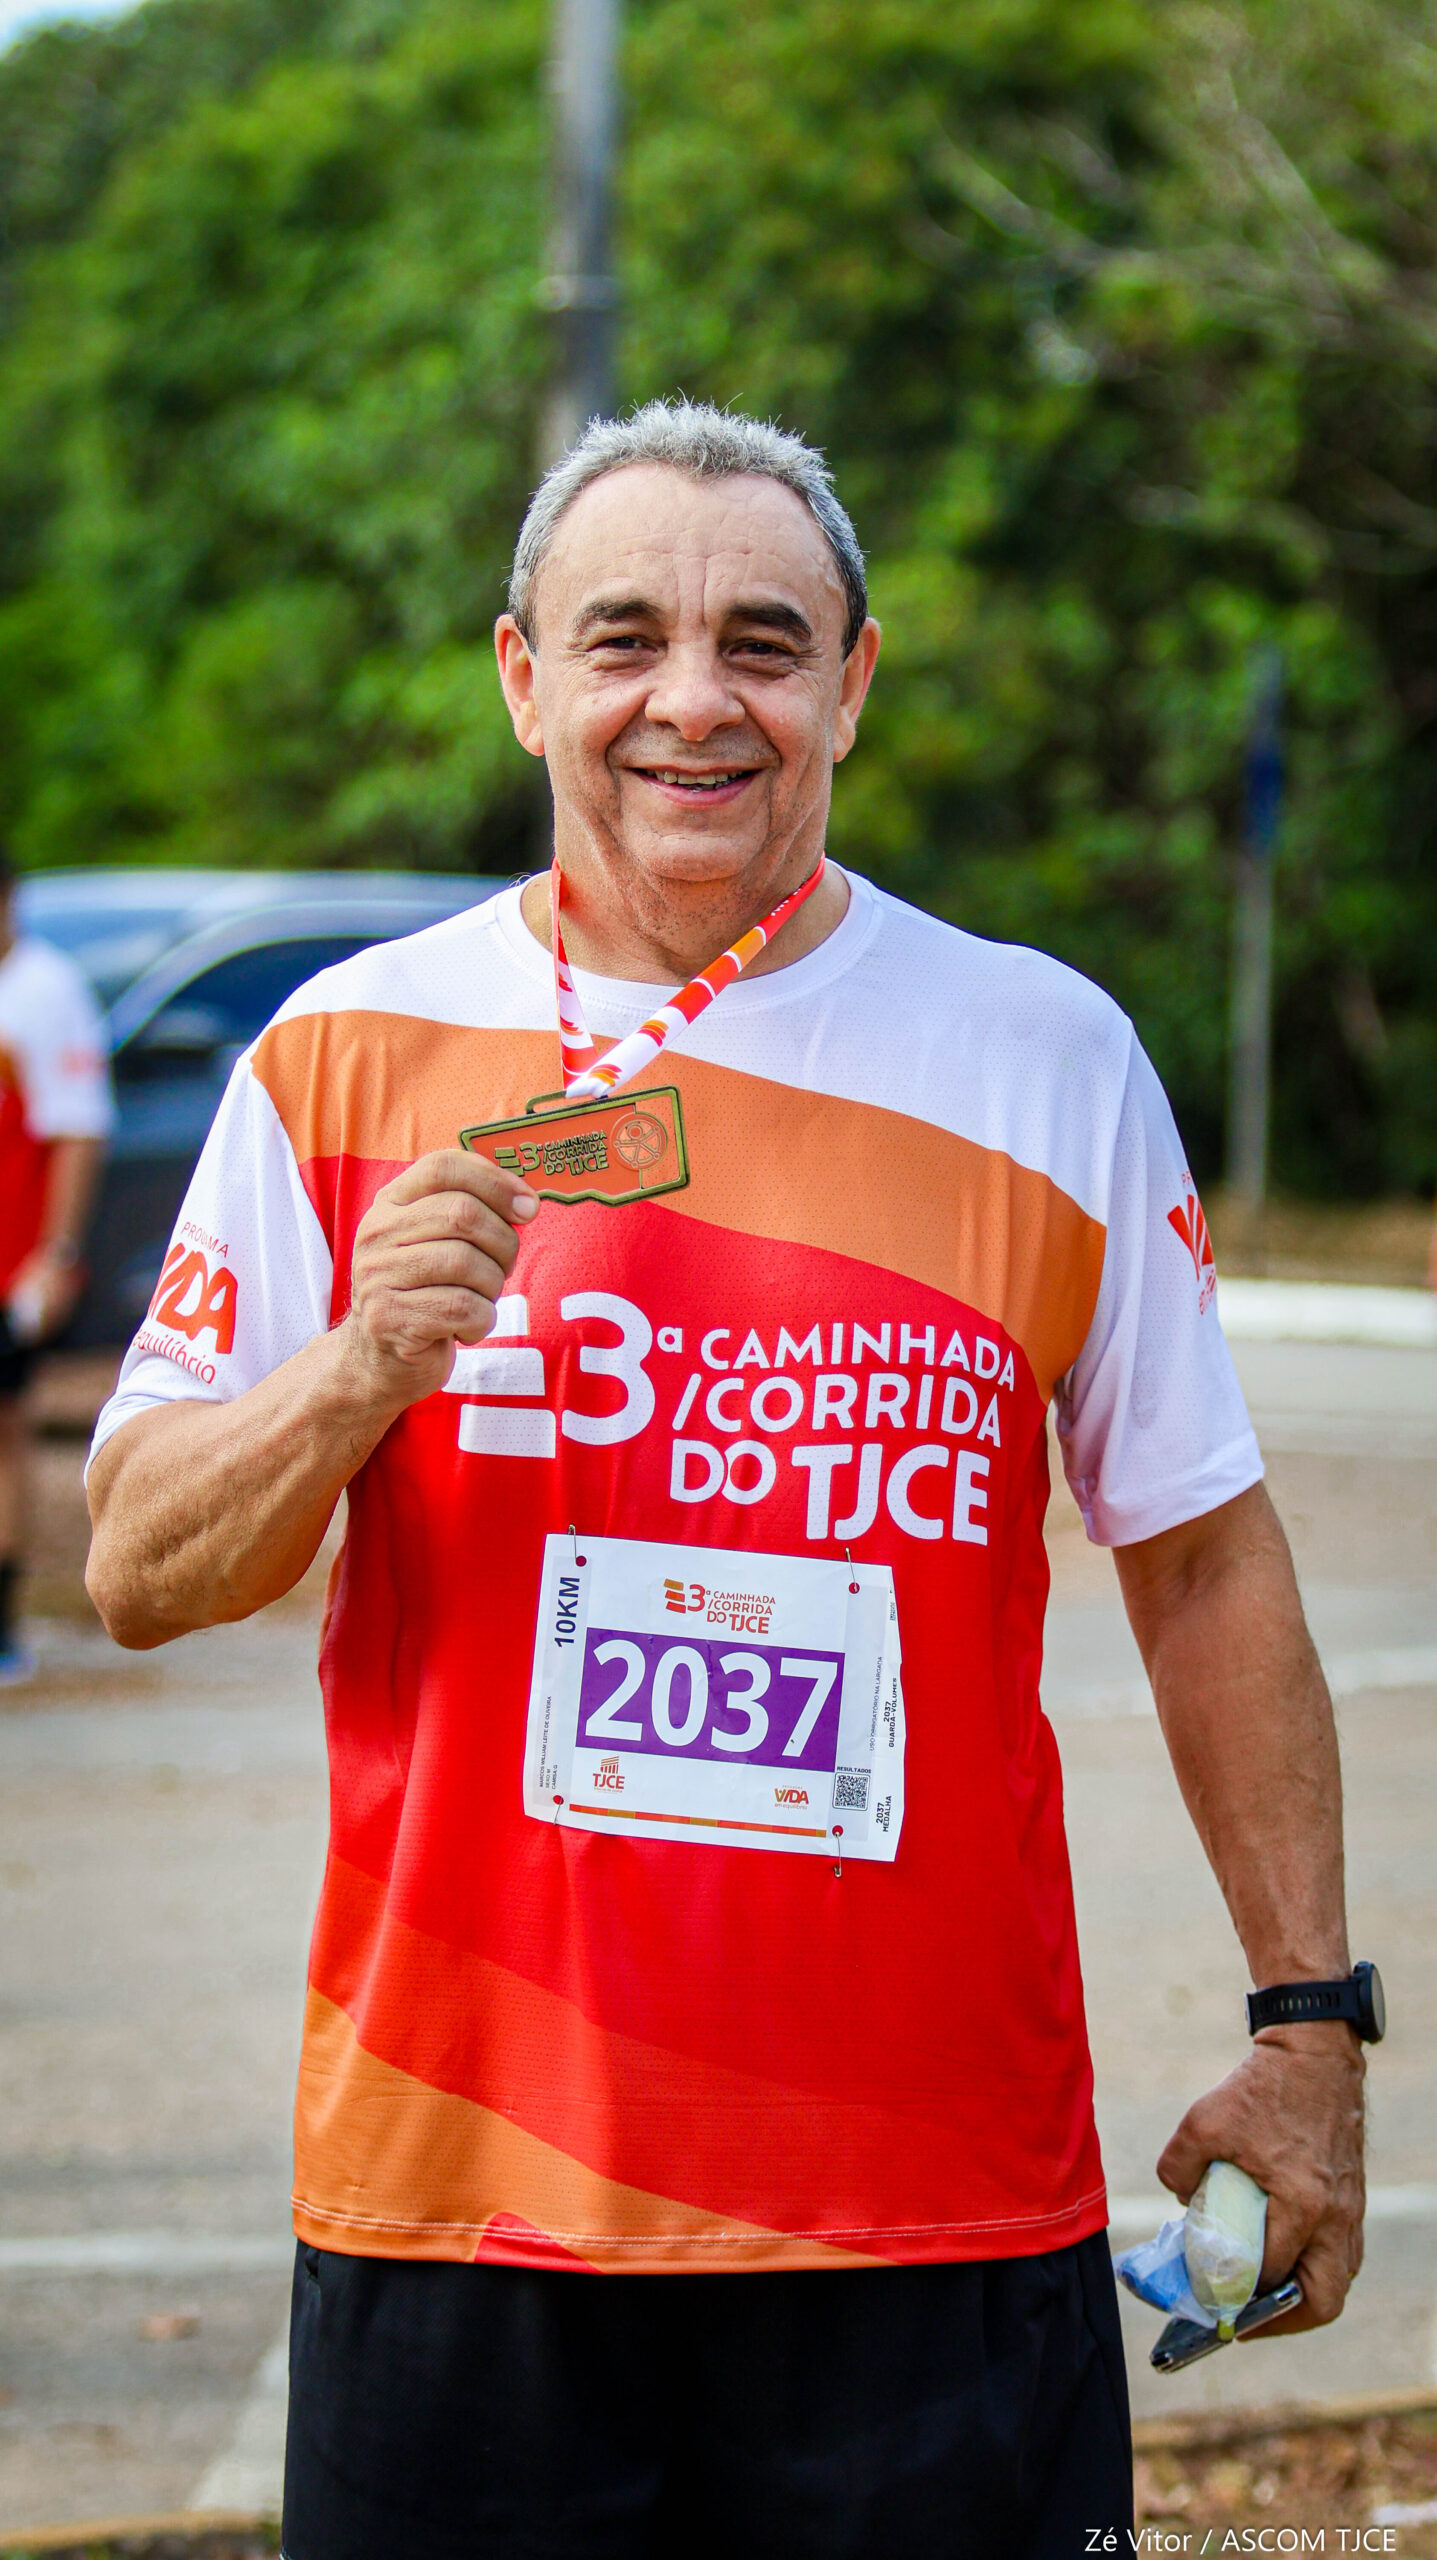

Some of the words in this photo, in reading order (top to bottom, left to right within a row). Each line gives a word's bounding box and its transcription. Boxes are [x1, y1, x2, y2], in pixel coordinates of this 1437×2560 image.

[544, 1129, 608, 1151] CAMINHADA
[544, 1159, 566, 1176] DO
[565, 1150, 609, 1177] TJCE
[700, 1322, 1017, 1393] CAMINHADA
[672, 1372, 1003, 1448] /CORRIDA
[669, 1438, 777, 1505] DO
[791, 1443, 991, 1547] TJCE
[707, 1598, 773, 1615] /CORRIDA
[713, 1590, 776, 1605] CAMINHADA
[554, 1576, 580, 1648] 10KM
[706, 1610, 727, 1624] DO
[729, 1613, 770, 1634] TJCE
[584, 1638, 839, 1758] 2037
[883, 1701, 892, 1723] 2037
[888, 1677, 897, 1748] GUARDA-VOLUMES
[592, 1772, 626, 1790] TJCE
[836, 1766, 872, 1774] RESULTADOS
[875, 1802, 885, 1824] 2037
[882, 1795, 892, 1833] MEDALHA
